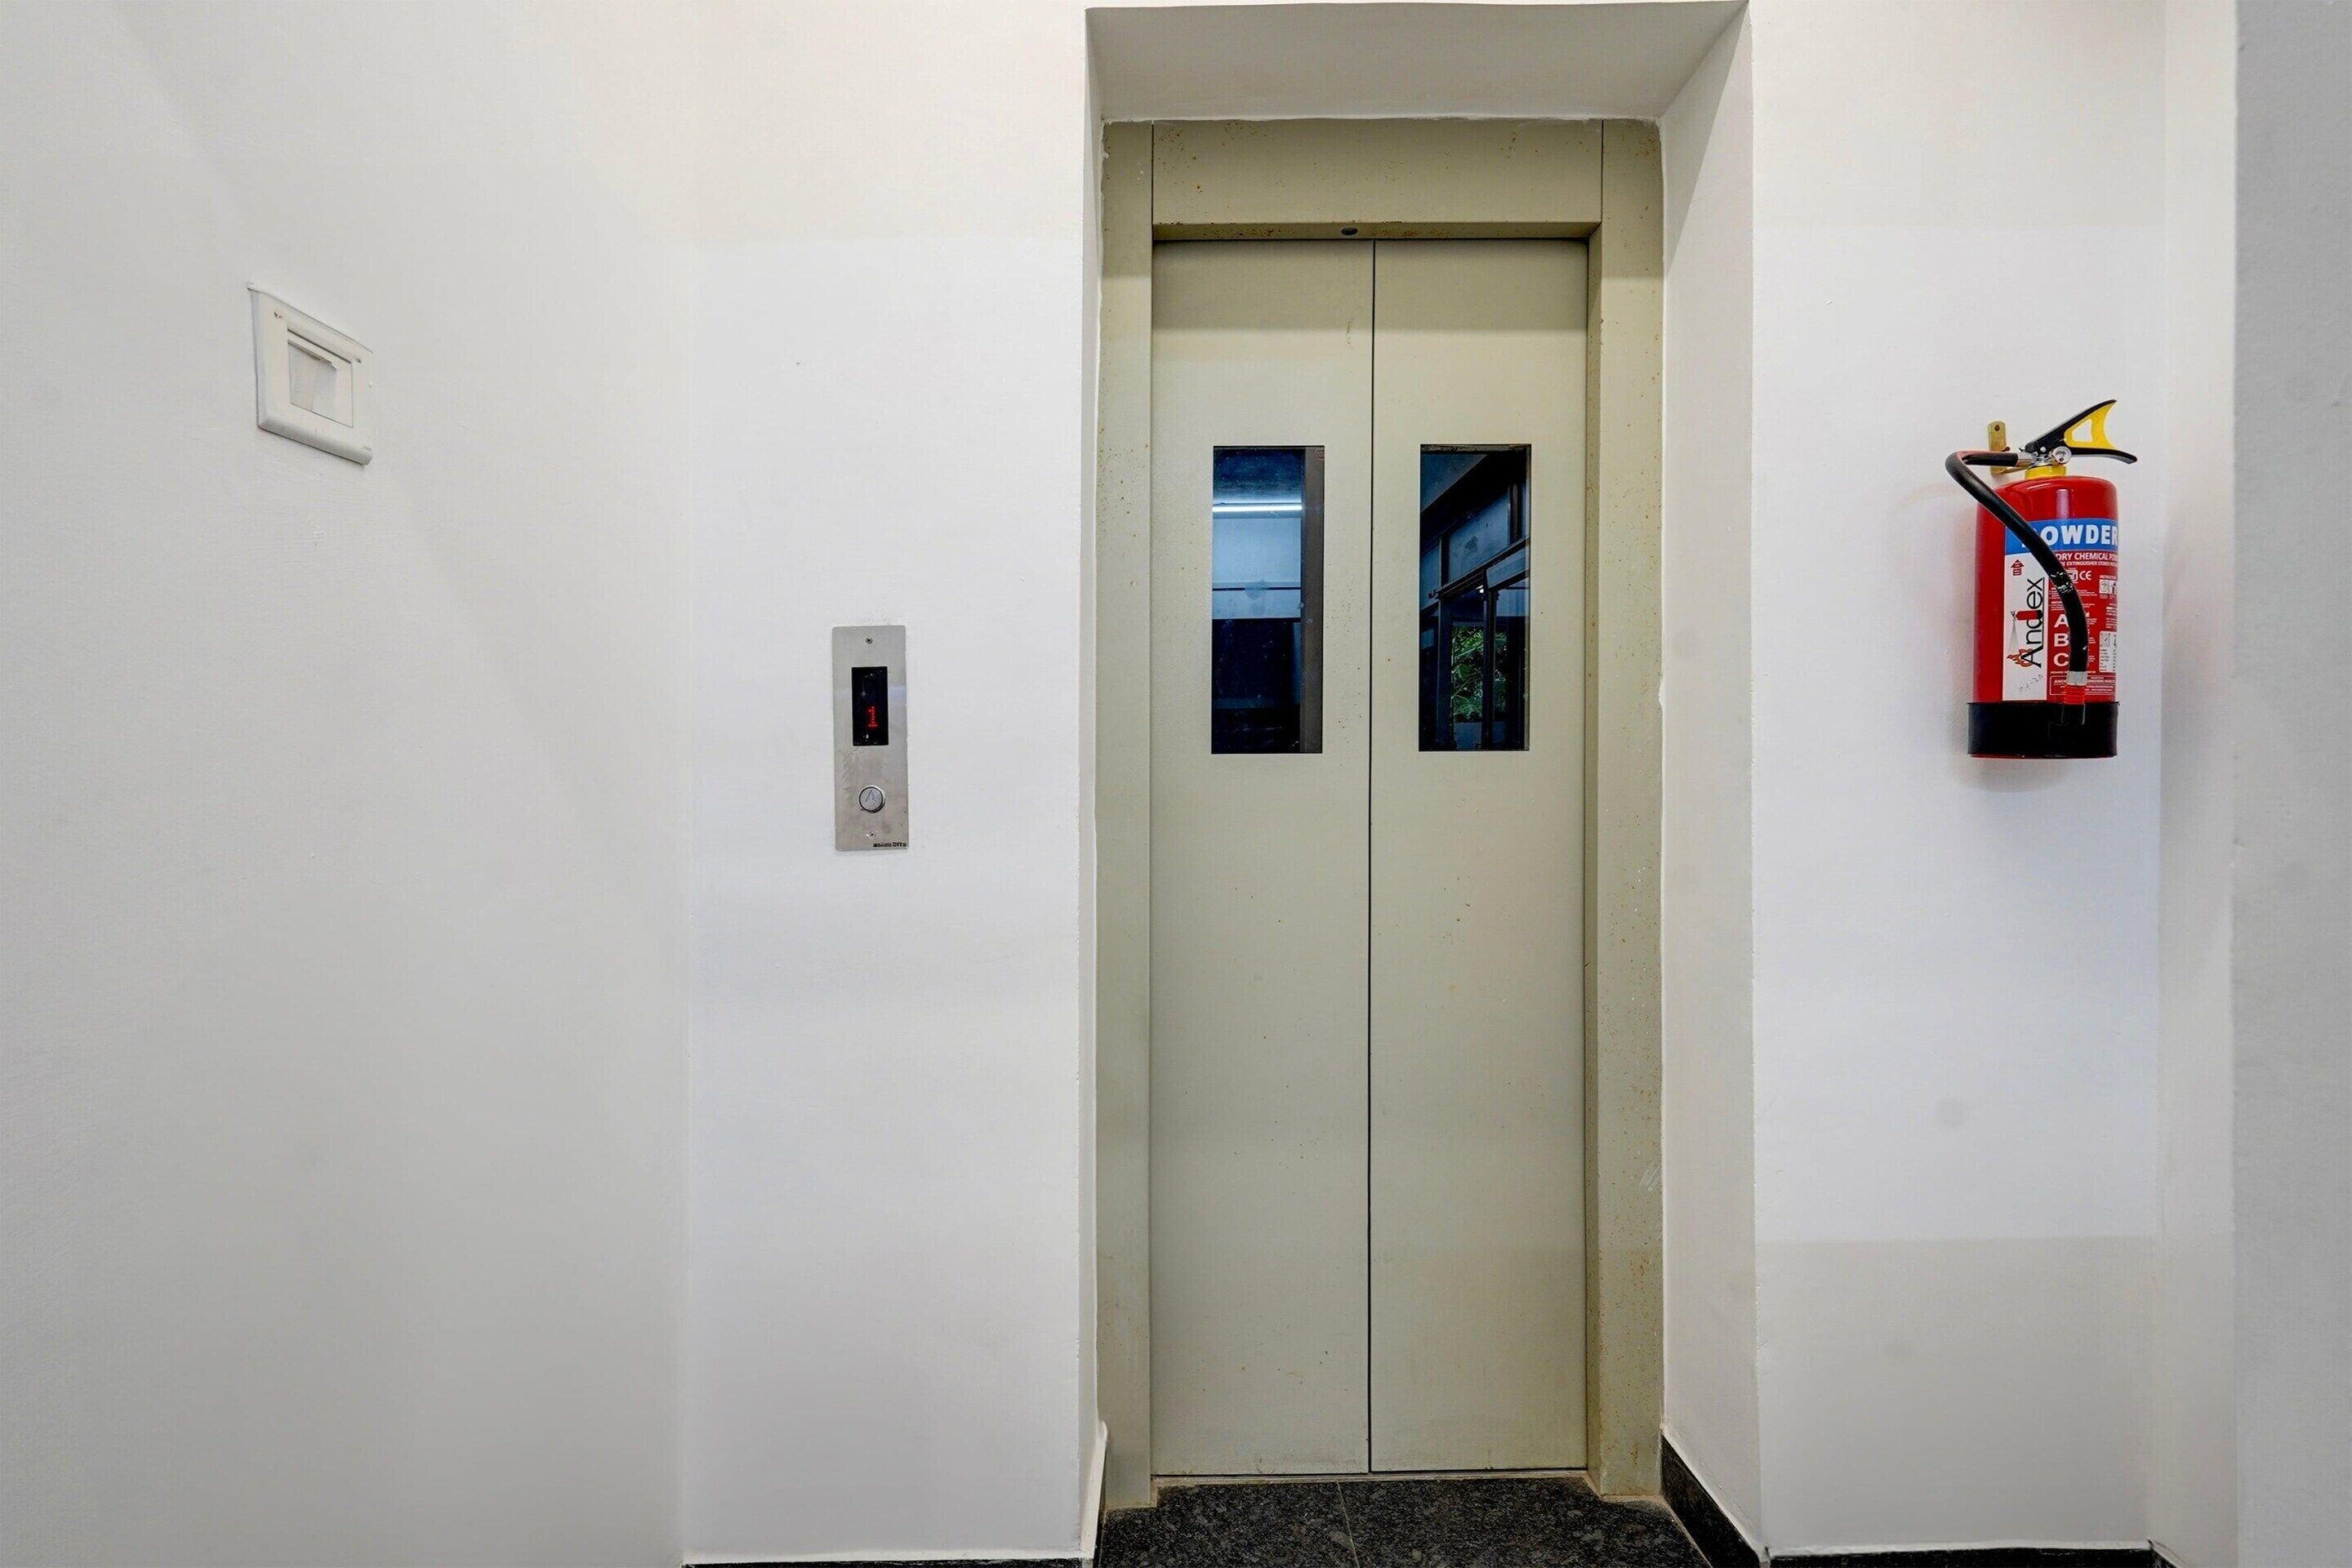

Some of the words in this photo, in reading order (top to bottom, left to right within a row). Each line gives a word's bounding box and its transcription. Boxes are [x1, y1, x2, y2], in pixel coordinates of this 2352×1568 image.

[2021, 524, 2118, 547] OWDER
[2074, 552, 2108, 560] CHEMICAL
[2079, 570, 2091, 581] CE
[2020, 578, 2044, 668] Andex
[2054, 613, 2069, 628] A
[2054, 633, 2069, 647] B
[2053, 653, 2069, 666] C
[868, 706, 878, 727] 1
